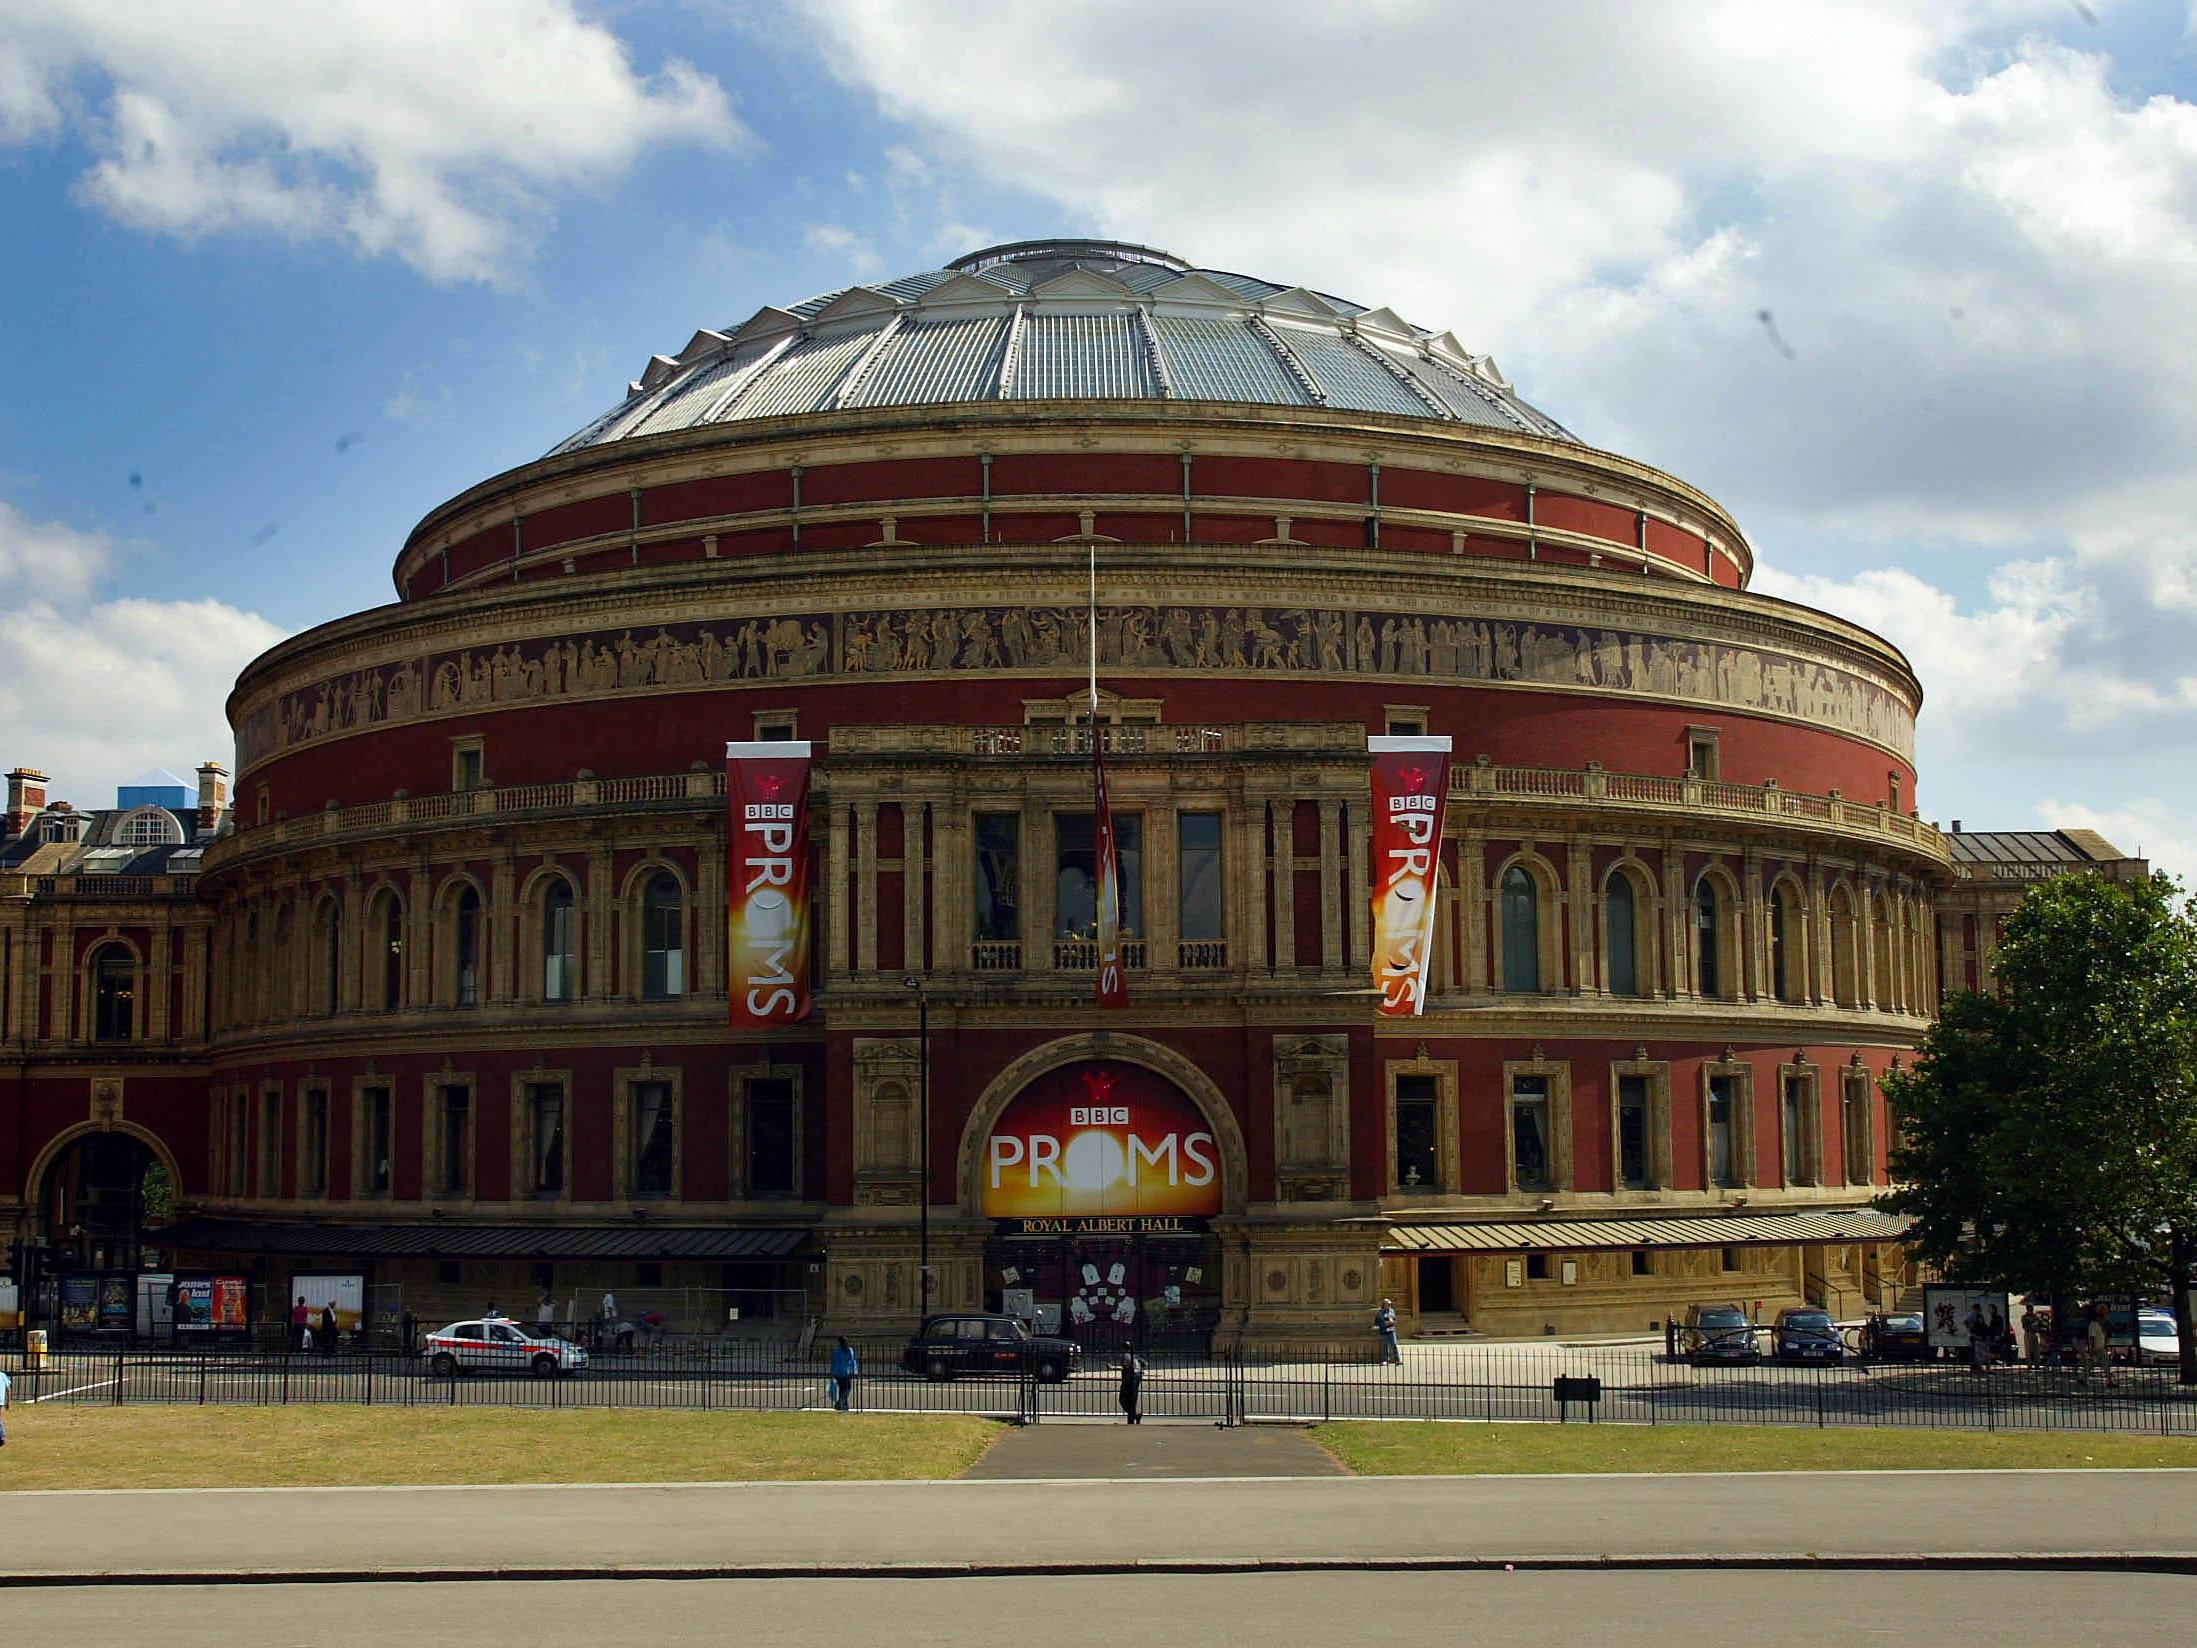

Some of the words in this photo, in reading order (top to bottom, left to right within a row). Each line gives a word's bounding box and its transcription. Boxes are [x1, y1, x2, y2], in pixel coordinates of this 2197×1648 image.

[744, 804, 794, 819] BBC
[1389, 795, 1436, 811] BBC
[744, 822, 795, 1016] PROMS
[1381, 813, 1434, 1008] PROMS
[1071, 1107, 1128, 1125] BBC
[990, 1131, 1215, 1191] PROMS
[1023, 1219, 1071, 1233] ROYAL
[1077, 1218, 1135, 1232] ALBERT
[1140, 1217, 1183, 1231] HALL
